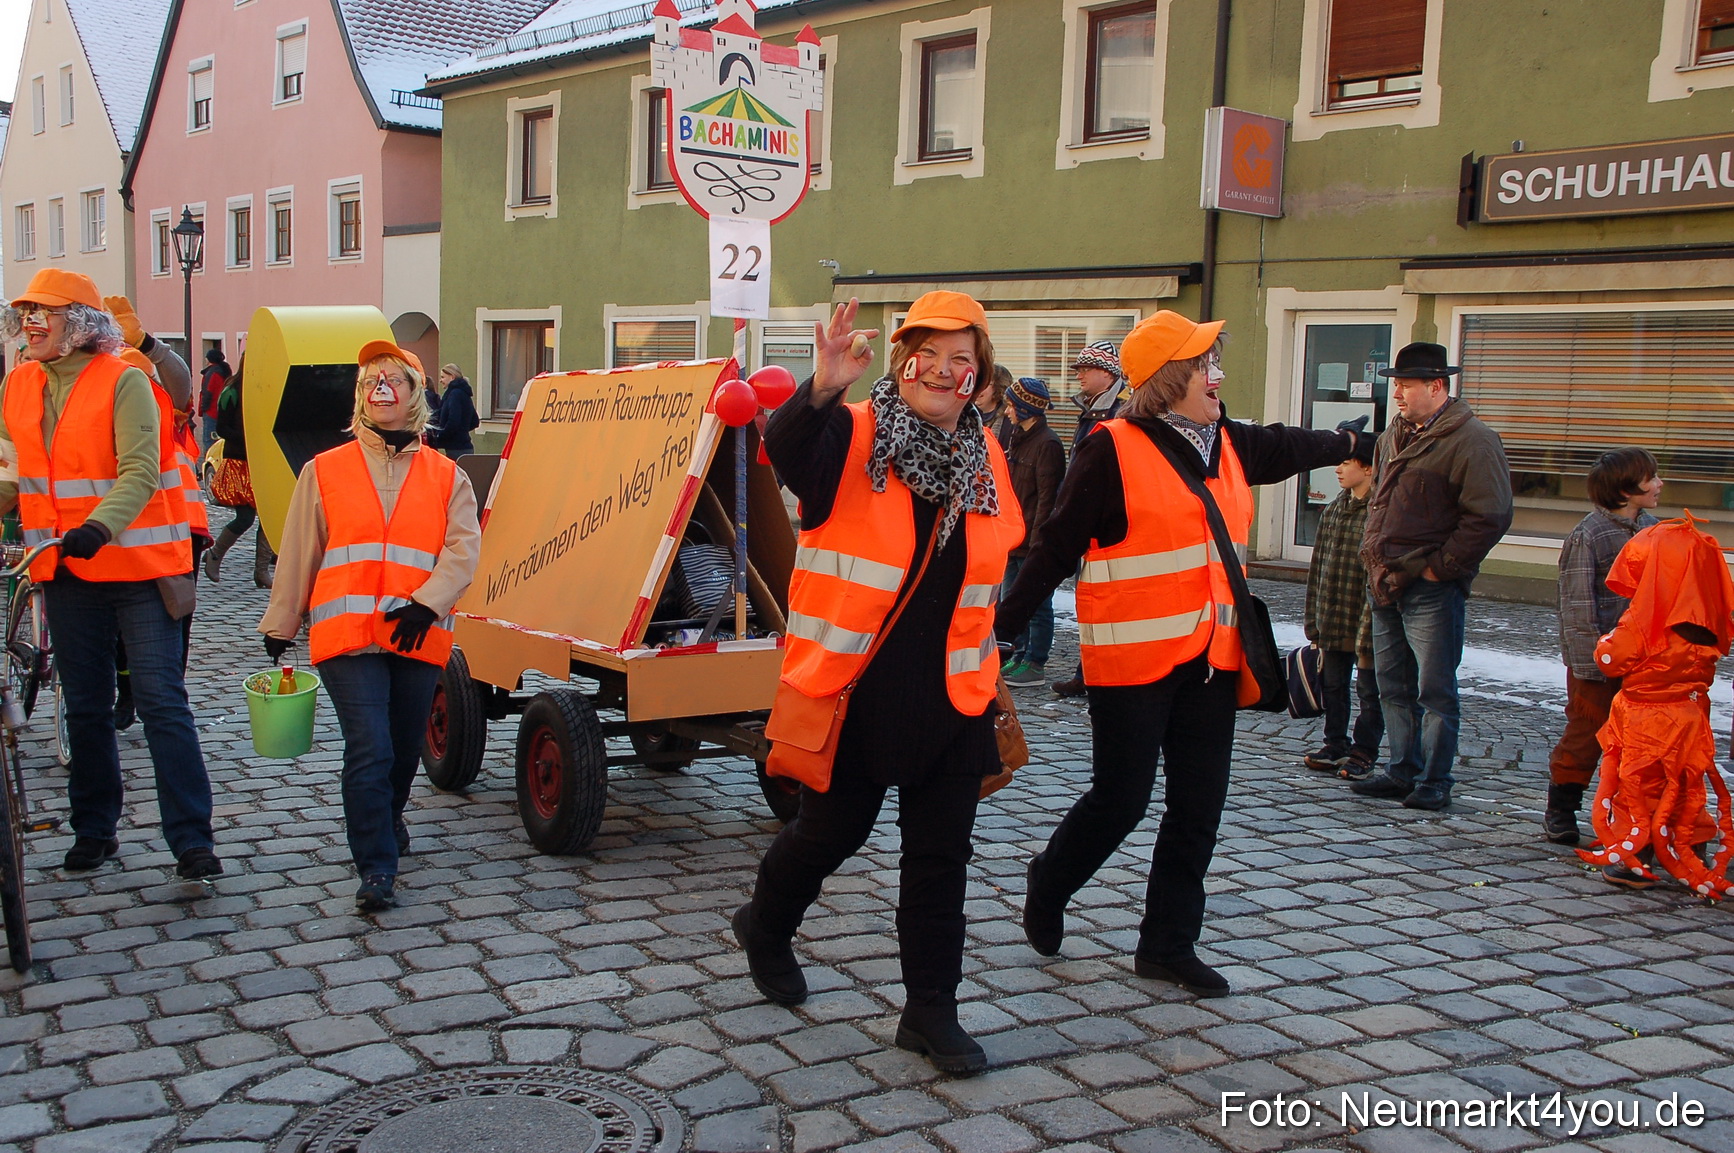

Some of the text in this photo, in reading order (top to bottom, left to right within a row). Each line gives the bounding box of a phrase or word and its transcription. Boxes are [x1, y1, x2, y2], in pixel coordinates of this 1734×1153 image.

[679, 115, 799, 157] BACHAMINIS
[1225, 190, 1275, 205] GARANT SCHUH
[718, 243, 762, 281] 22
[539, 383, 694, 428] Bachamini Räumtrupp
[486, 560, 515, 606] Wir
[514, 521, 578, 588] räumen
[579, 500, 613, 541] den
[618, 458, 656, 514] Weg
